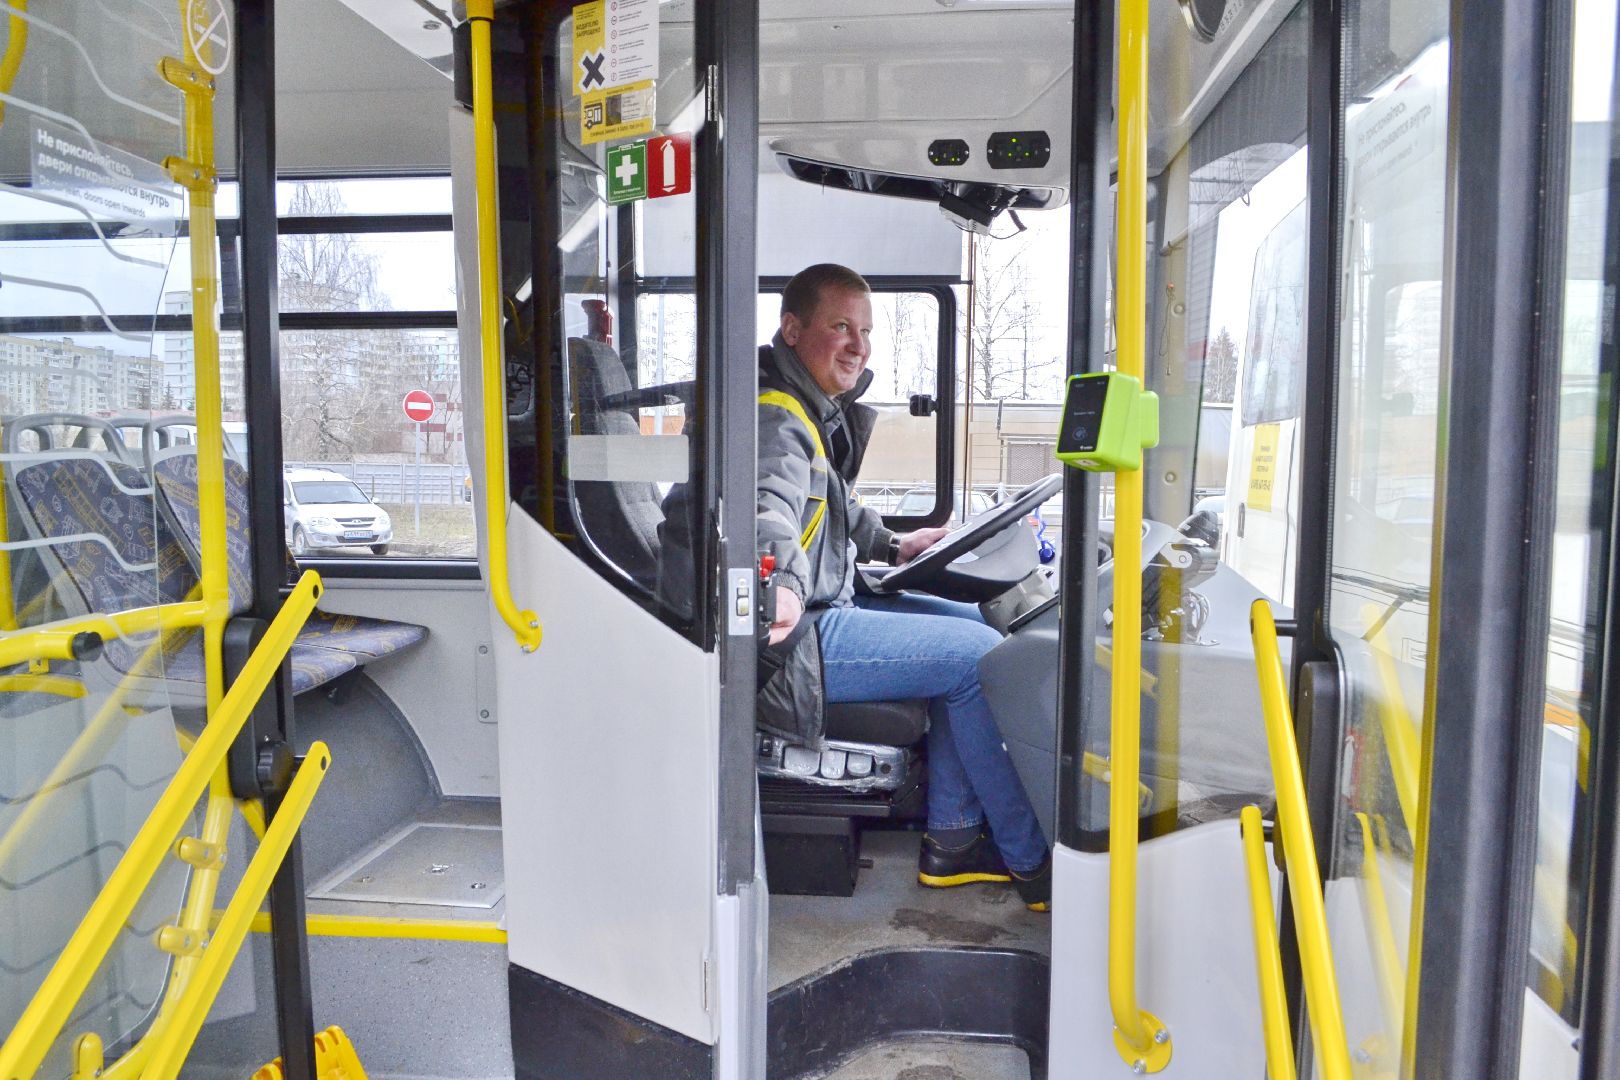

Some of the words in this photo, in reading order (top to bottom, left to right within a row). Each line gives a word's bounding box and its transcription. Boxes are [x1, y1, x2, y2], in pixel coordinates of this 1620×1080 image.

[37, 128, 54, 148] Не
[37, 152, 73, 175] двери
[139, 189, 170, 208] внутрь
[84, 191, 104, 205] doors
[104, 199, 121, 212] open
[122, 205, 146, 218] inwards
